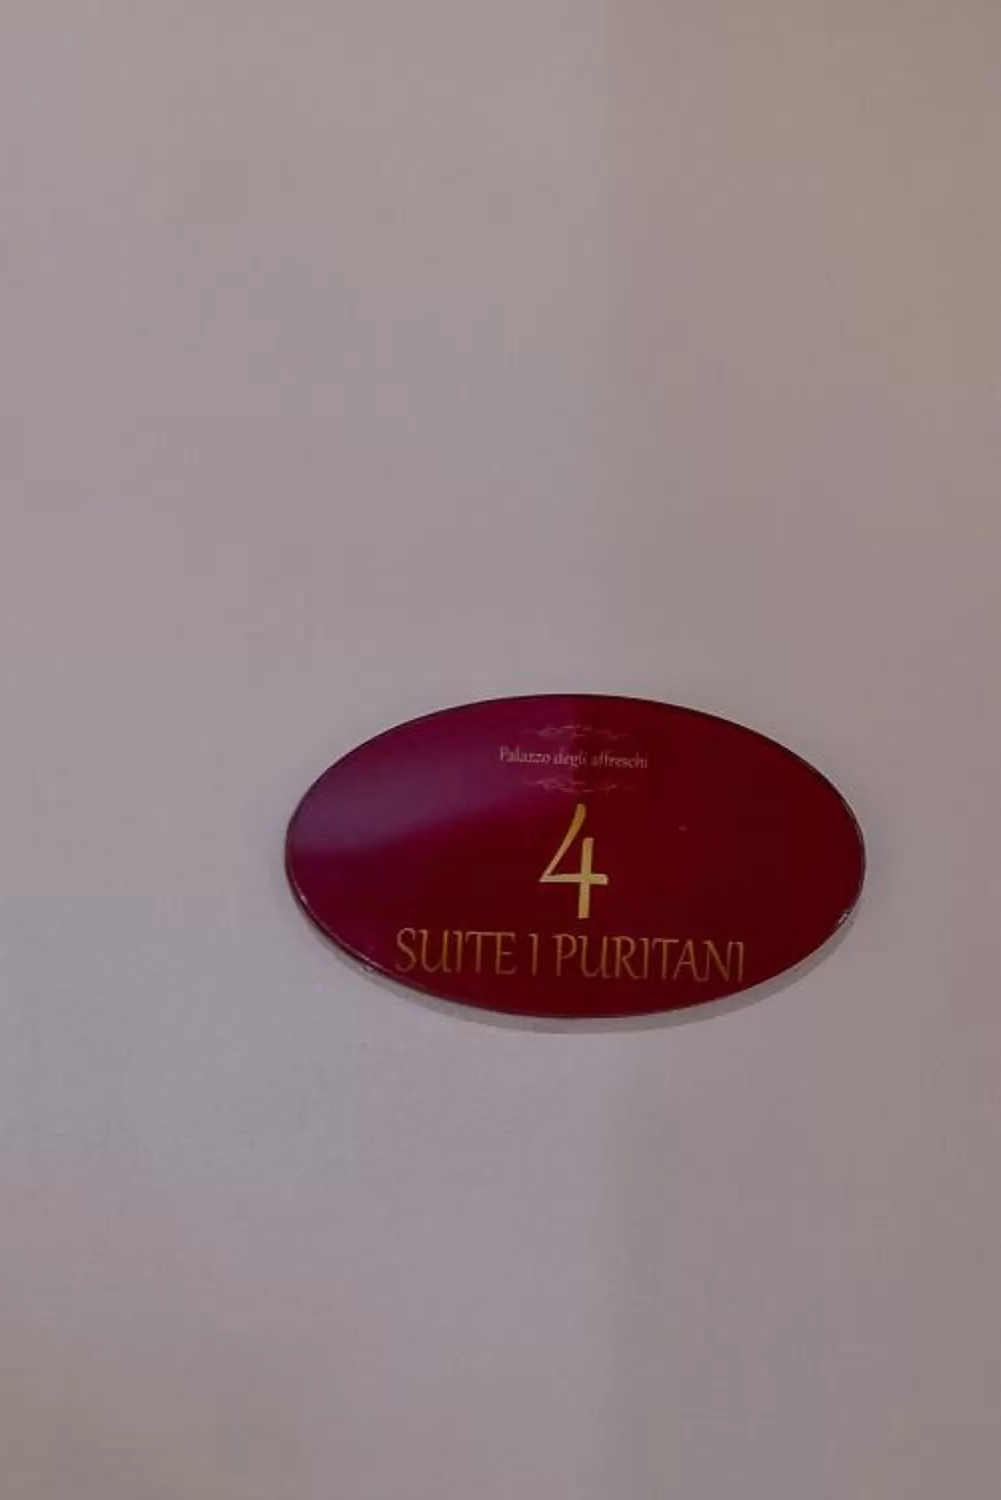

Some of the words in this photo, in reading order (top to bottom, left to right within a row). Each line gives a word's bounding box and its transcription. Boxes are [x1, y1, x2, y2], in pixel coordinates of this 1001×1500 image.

[499, 746, 550, 764] Palazzo
[552, 748, 587, 768] degli
[539, 803, 608, 919] 4
[395, 927, 517, 975] SUITE
[527, 932, 539, 977] I
[551, 932, 745, 983] PURITANI
